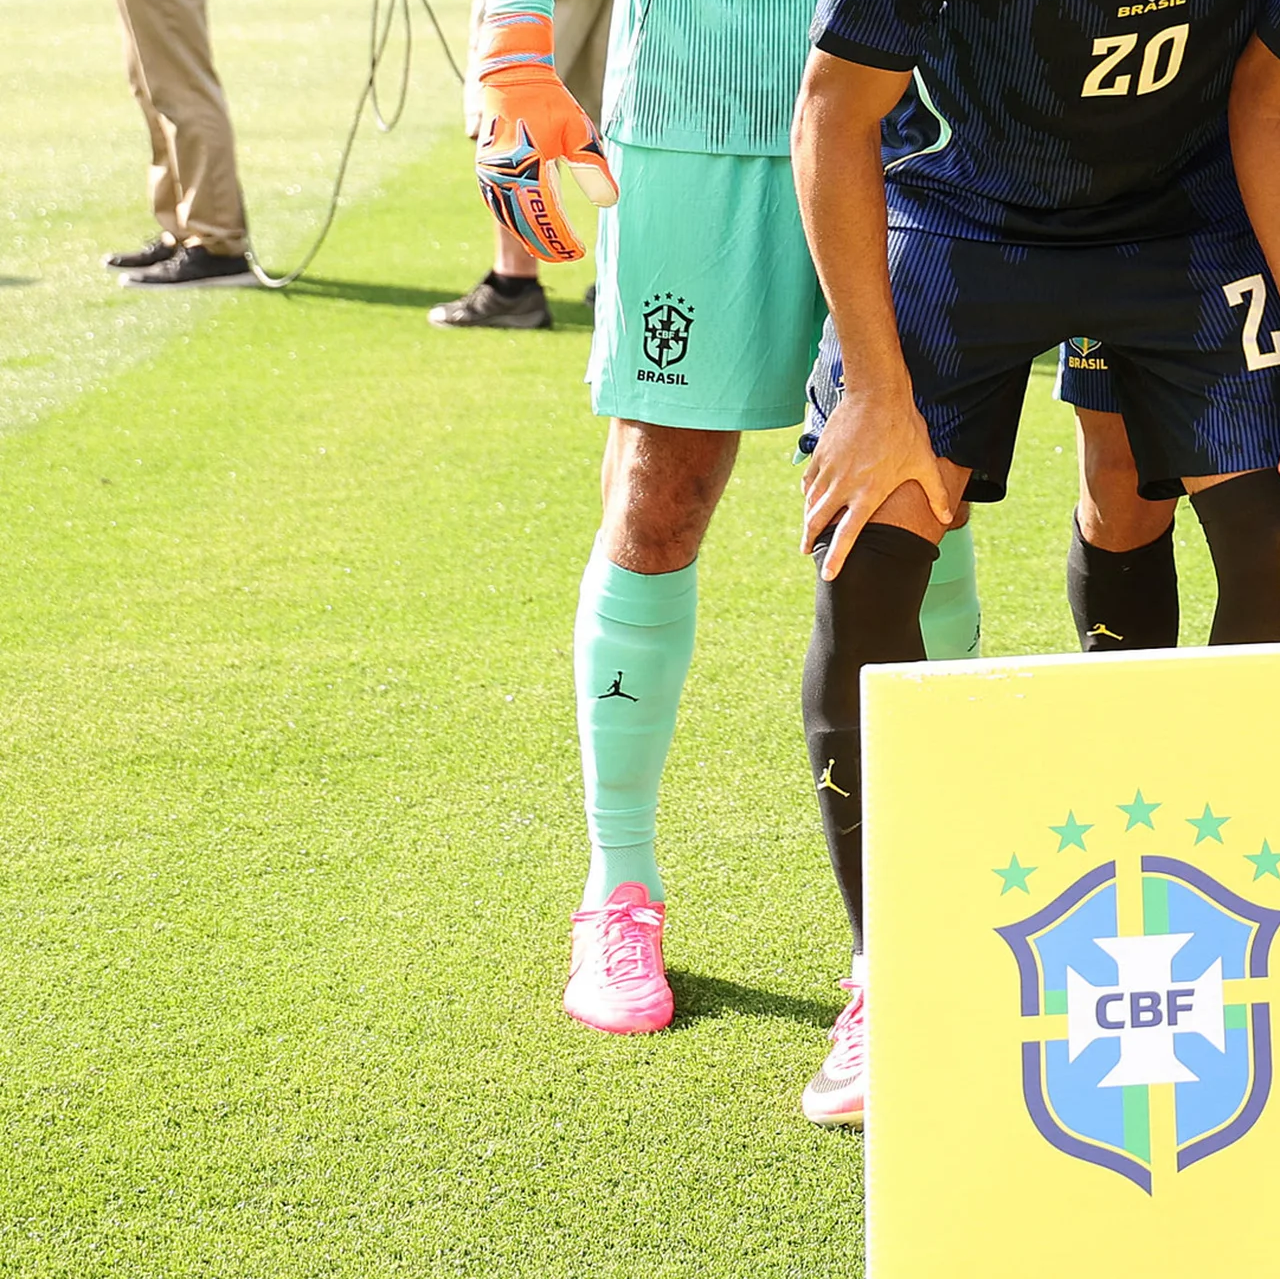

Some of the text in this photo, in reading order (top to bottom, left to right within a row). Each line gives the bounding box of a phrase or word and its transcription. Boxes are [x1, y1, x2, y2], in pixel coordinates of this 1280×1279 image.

[1080, 23, 1189, 97] 20
[527, 187, 575, 260] reusch
[656, 330, 675, 339] CBF
[637, 369, 689, 385] BRASIL
[1068, 356, 1109, 370] BRASIL
[1094, 988, 1196, 1032] CBF
